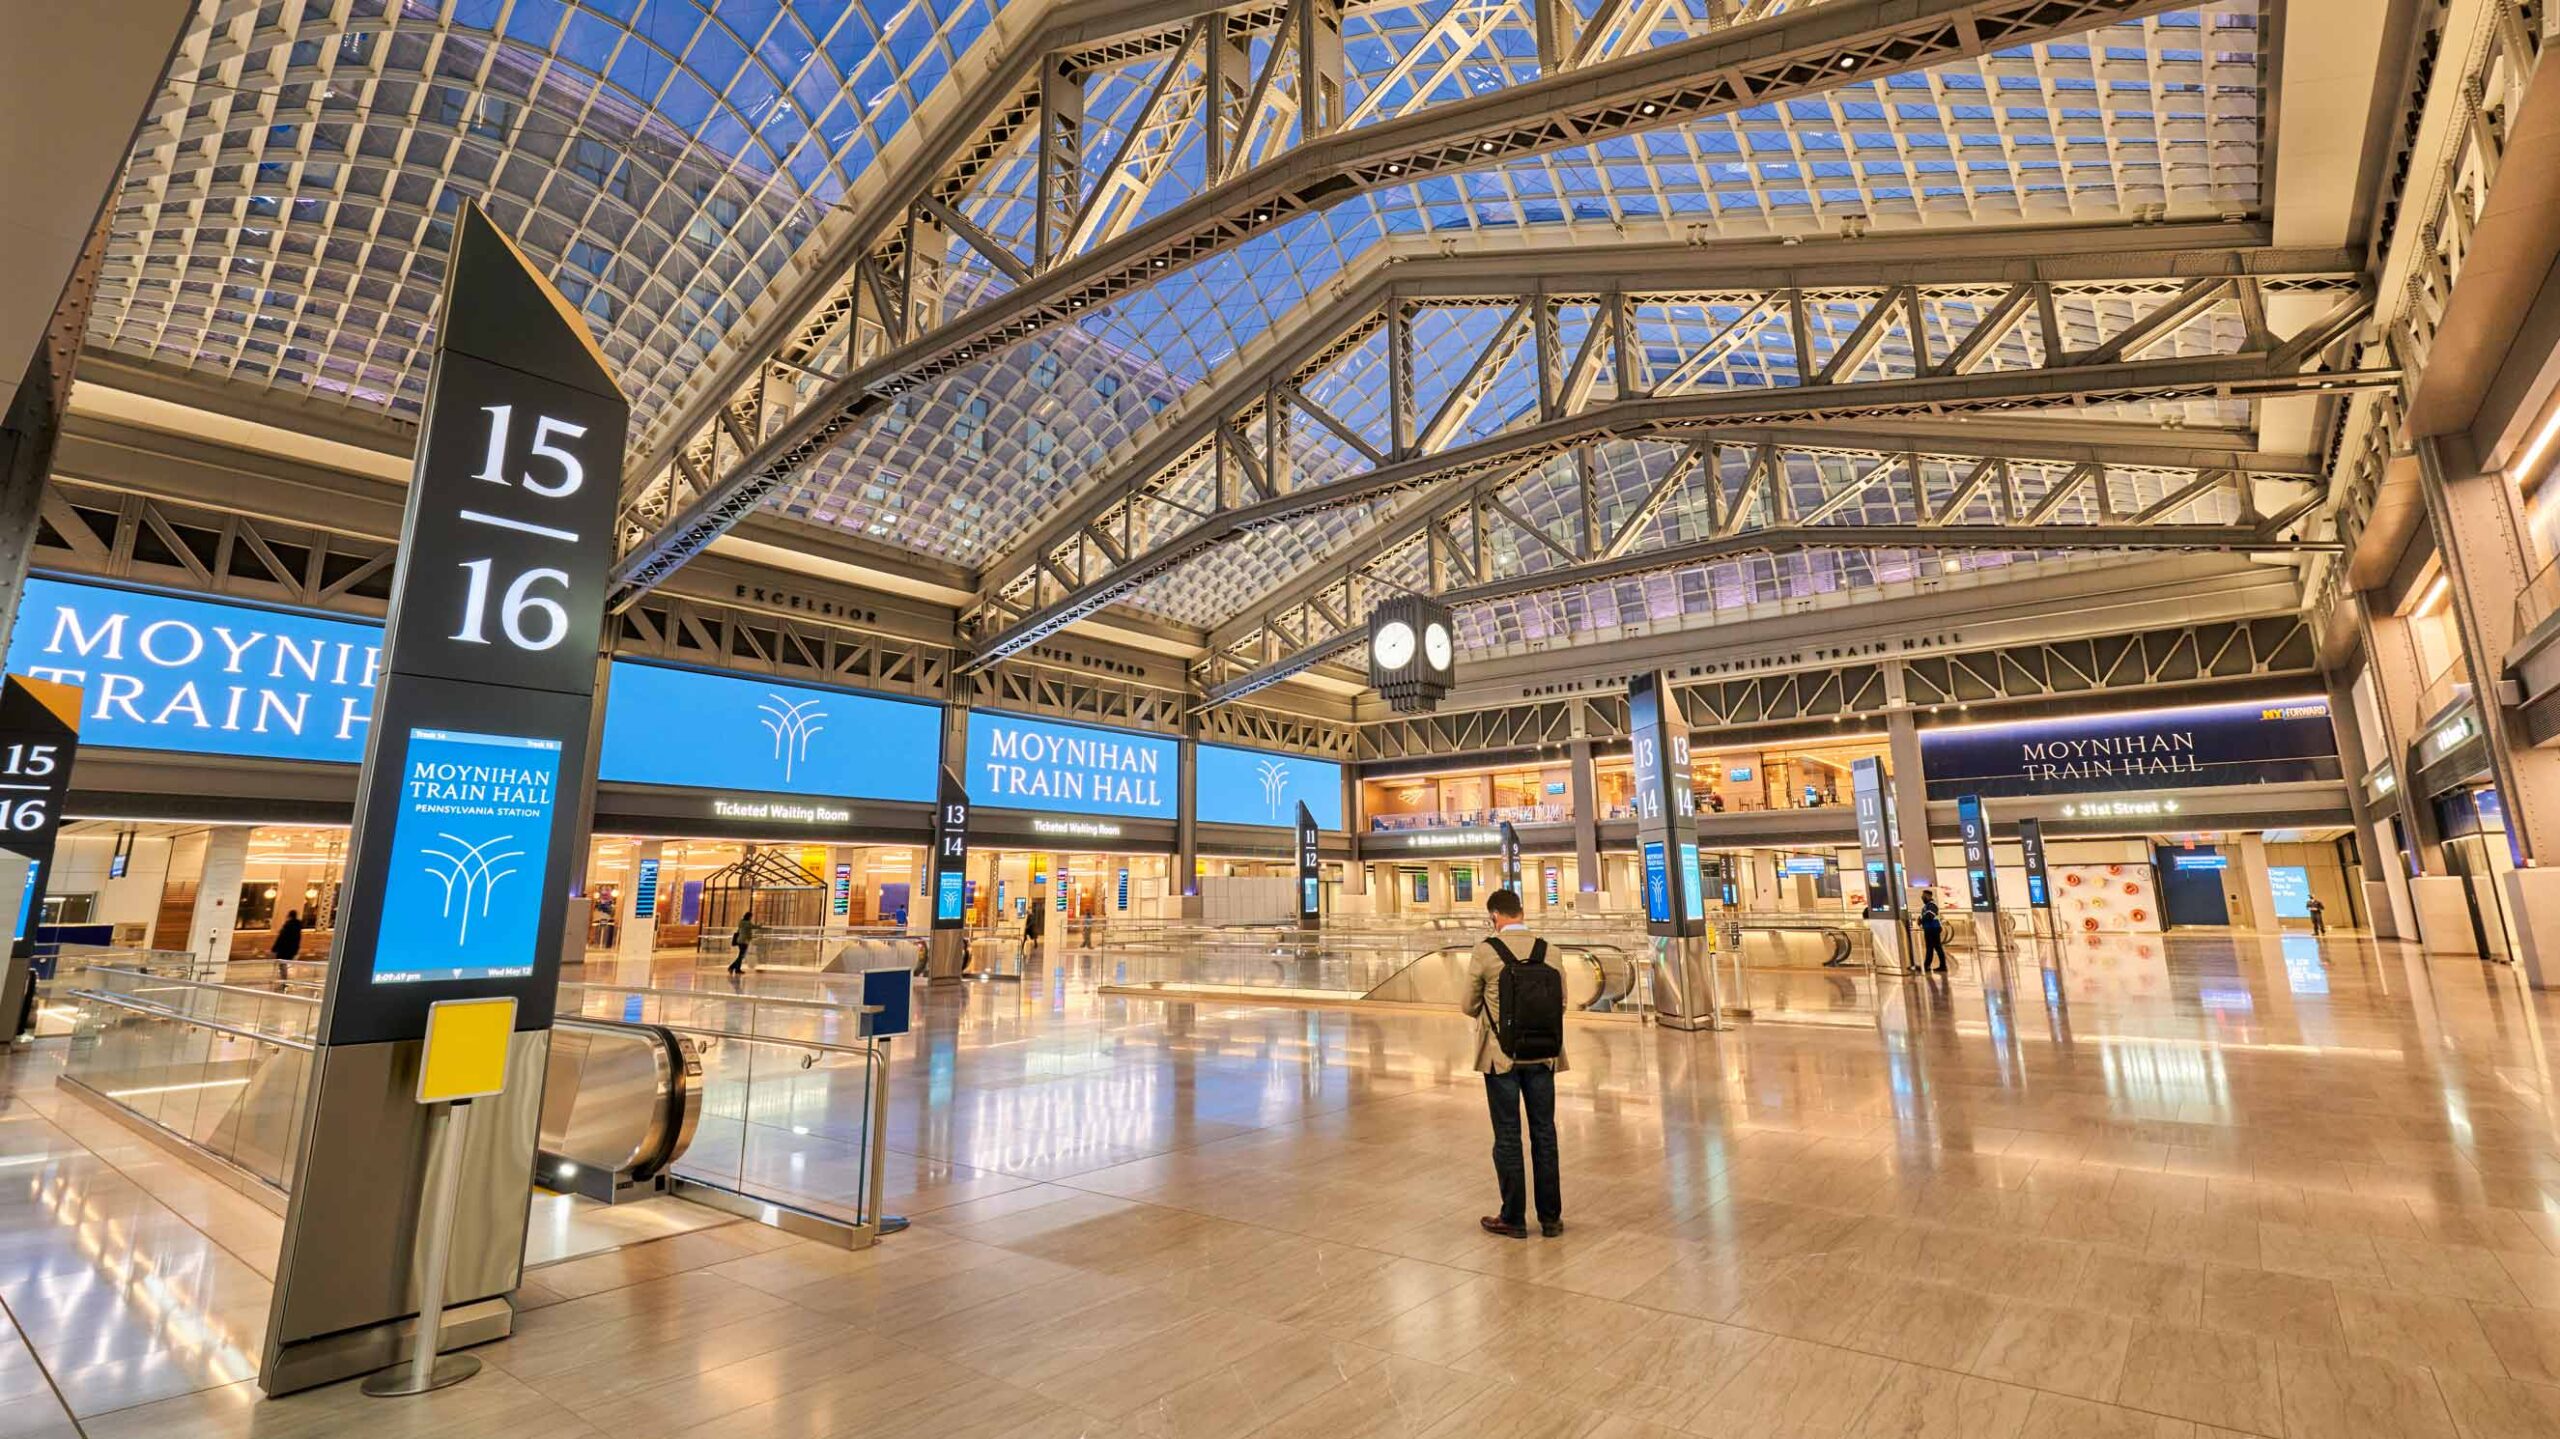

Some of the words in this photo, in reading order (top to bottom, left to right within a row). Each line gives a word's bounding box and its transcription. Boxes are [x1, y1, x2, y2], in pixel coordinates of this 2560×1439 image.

[470, 404, 588, 498] 15
[447, 558, 570, 651] 16
[735, 584, 877, 623] EXCELSIOR
[1032, 645, 1073, 662] EVER
[1082, 656, 1145, 677] UPWARD
[1523, 679, 1585, 698] DANIEL
[1596, 670, 1677, 689] PATK
[1690, 653, 1802, 677] MOYNIHAN
[1816, 642, 1887, 661] TRAIN
[1903, 633, 1963, 650] HALL
[2285, 705, 2327, 717] FORWARD
[990, 728, 1158, 774] MOYNIHAN
[1639, 738, 1654, 768] 13
[1672, 735, 1689, 766] 13
[2022, 732, 2194, 761] MOYNIHAN
[2, 743, 58, 776] 15
[2022, 758, 2113, 782] TRAIN
[2122, 754, 2204, 776] HALL
[413, 762, 550, 786] MOYNIHAN
[986, 763, 1084, 800] TRAIN
[1093, 774, 1162, 806] HALL
[410, 781, 486, 801] TRAIN
[493, 786, 550, 804] HALL
[1642, 788, 1658, 819] 14
[1677, 787, 1693, 817] 14
[0, 800, 47, 831] 16
[415, 804, 494, 815] PENNSYLVANIA
[497, 807, 541, 817] STATION
[714, 801, 768, 817] Ticketed
[770, 804, 814, 822] Waiting
[816, 807, 849, 821] Room
[946, 804, 965, 824] 13
[1862, 797, 1874, 816] 11
[2079, 802, 2110, 816] 31st
[2112, 801, 2160, 815] Street
[1033, 820, 1068, 833] Ticketed
[1069, 822, 1098, 837] Waiting
[1099, 824, 1120, 836] Room
[1306, 829, 1316, 843] 11
[1865, 829, 1879, 848] 12
[1966, 824, 1975, 838] 9
[944, 836, 963, 856] 14
[1513, 844, 1519, 854] 9
[1968, 847, 1980, 861] 10
[2026, 840, 2033, 851] 7
[1305, 852, 1317, 866] 12
[2029, 857, 2037, 869] 8
